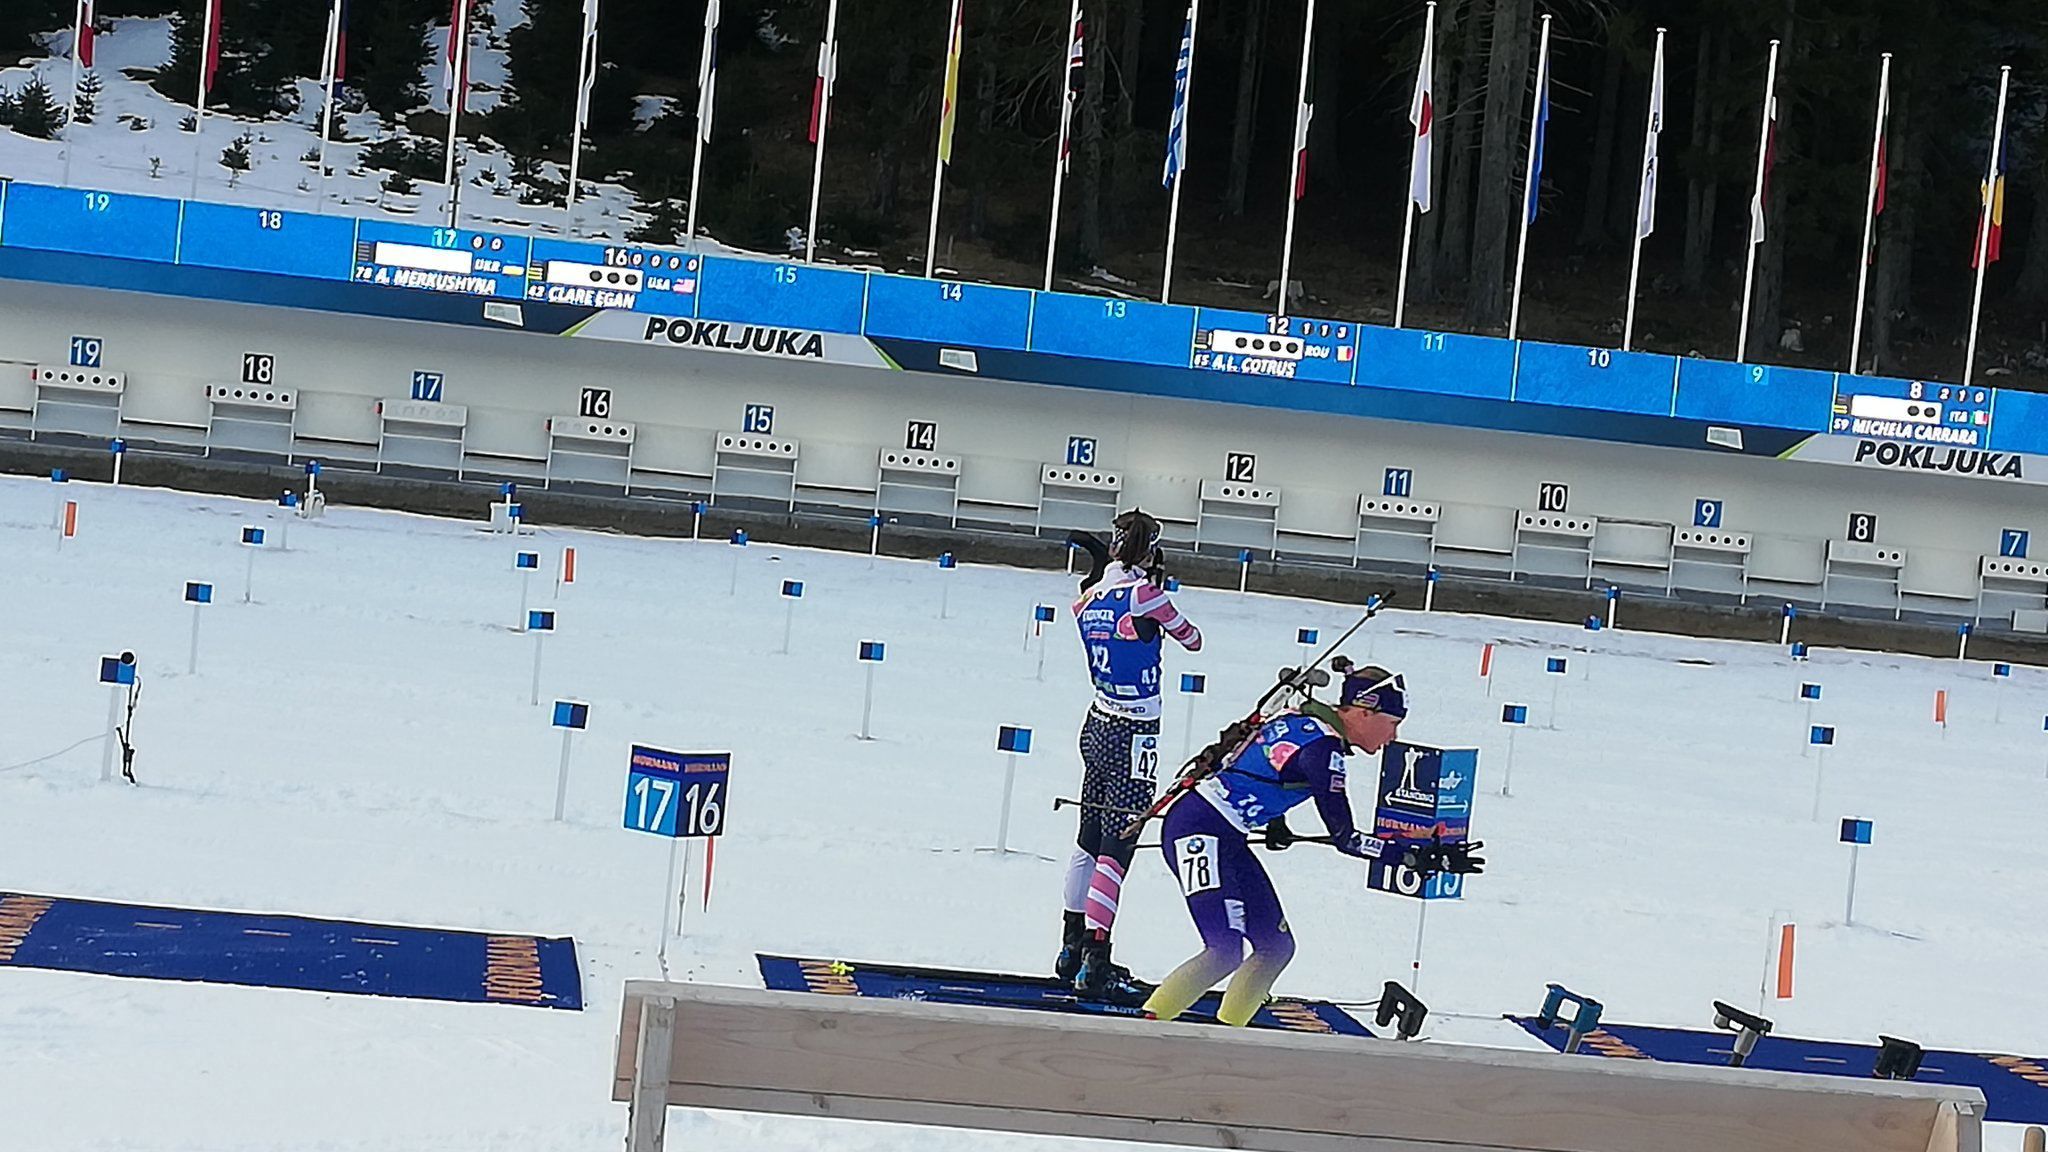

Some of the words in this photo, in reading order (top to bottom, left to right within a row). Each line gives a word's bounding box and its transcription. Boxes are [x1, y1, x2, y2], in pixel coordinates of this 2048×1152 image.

[84, 192, 110, 212] 19
[258, 210, 282, 230] 18
[432, 228, 457, 248] 17
[605, 247, 627, 266] 16
[394, 269, 497, 296] MERKUSHYNA
[647, 276, 671, 291] USA
[774, 265, 798, 285] 15
[548, 286, 595, 306] CLARE
[595, 290, 636, 309] EGAN
[940, 283, 963, 302] 14
[1104, 300, 1127, 319] 13
[644, 316, 824, 359] POKLJUKA
[1266, 316, 1289, 335] 12
[72, 339, 101, 367] 19
[1304, 345, 1330, 359] ROU
[1423, 333, 1444, 352] 11
[245, 355, 273, 383] 18
[1241, 358, 1297, 379] COTRUS
[1587, 349, 1610, 368] 10
[414, 372, 441, 400] 17
[1752, 366, 1764, 383] 9
[1910, 381, 1923, 399] 8
[582, 389, 609, 417] 16
[747, 406, 772, 432] 15
[1949, 410, 1968, 423] ITA
[908, 423, 934, 449] 14
[1852, 418, 1913, 440] MICHELA
[1914, 424, 1978, 446] CARRARA
[1069, 439, 1095, 465] 13
[1853, 440, 2024, 480] POKLJUKA
[1228, 455, 1254, 481] 12
[1387, 470, 1408, 496] 11
[1542, 485, 1566, 510] 10
[1701, 501, 1715, 527] 9
[1854, 516, 1869, 541] 8
[2008, 531, 2023, 556] 7
[1138, 751, 1158, 780] 42
[634, 777, 675, 832] 17
[685, 782, 720, 835] 16
[1182, 855, 1211, 892] 78
